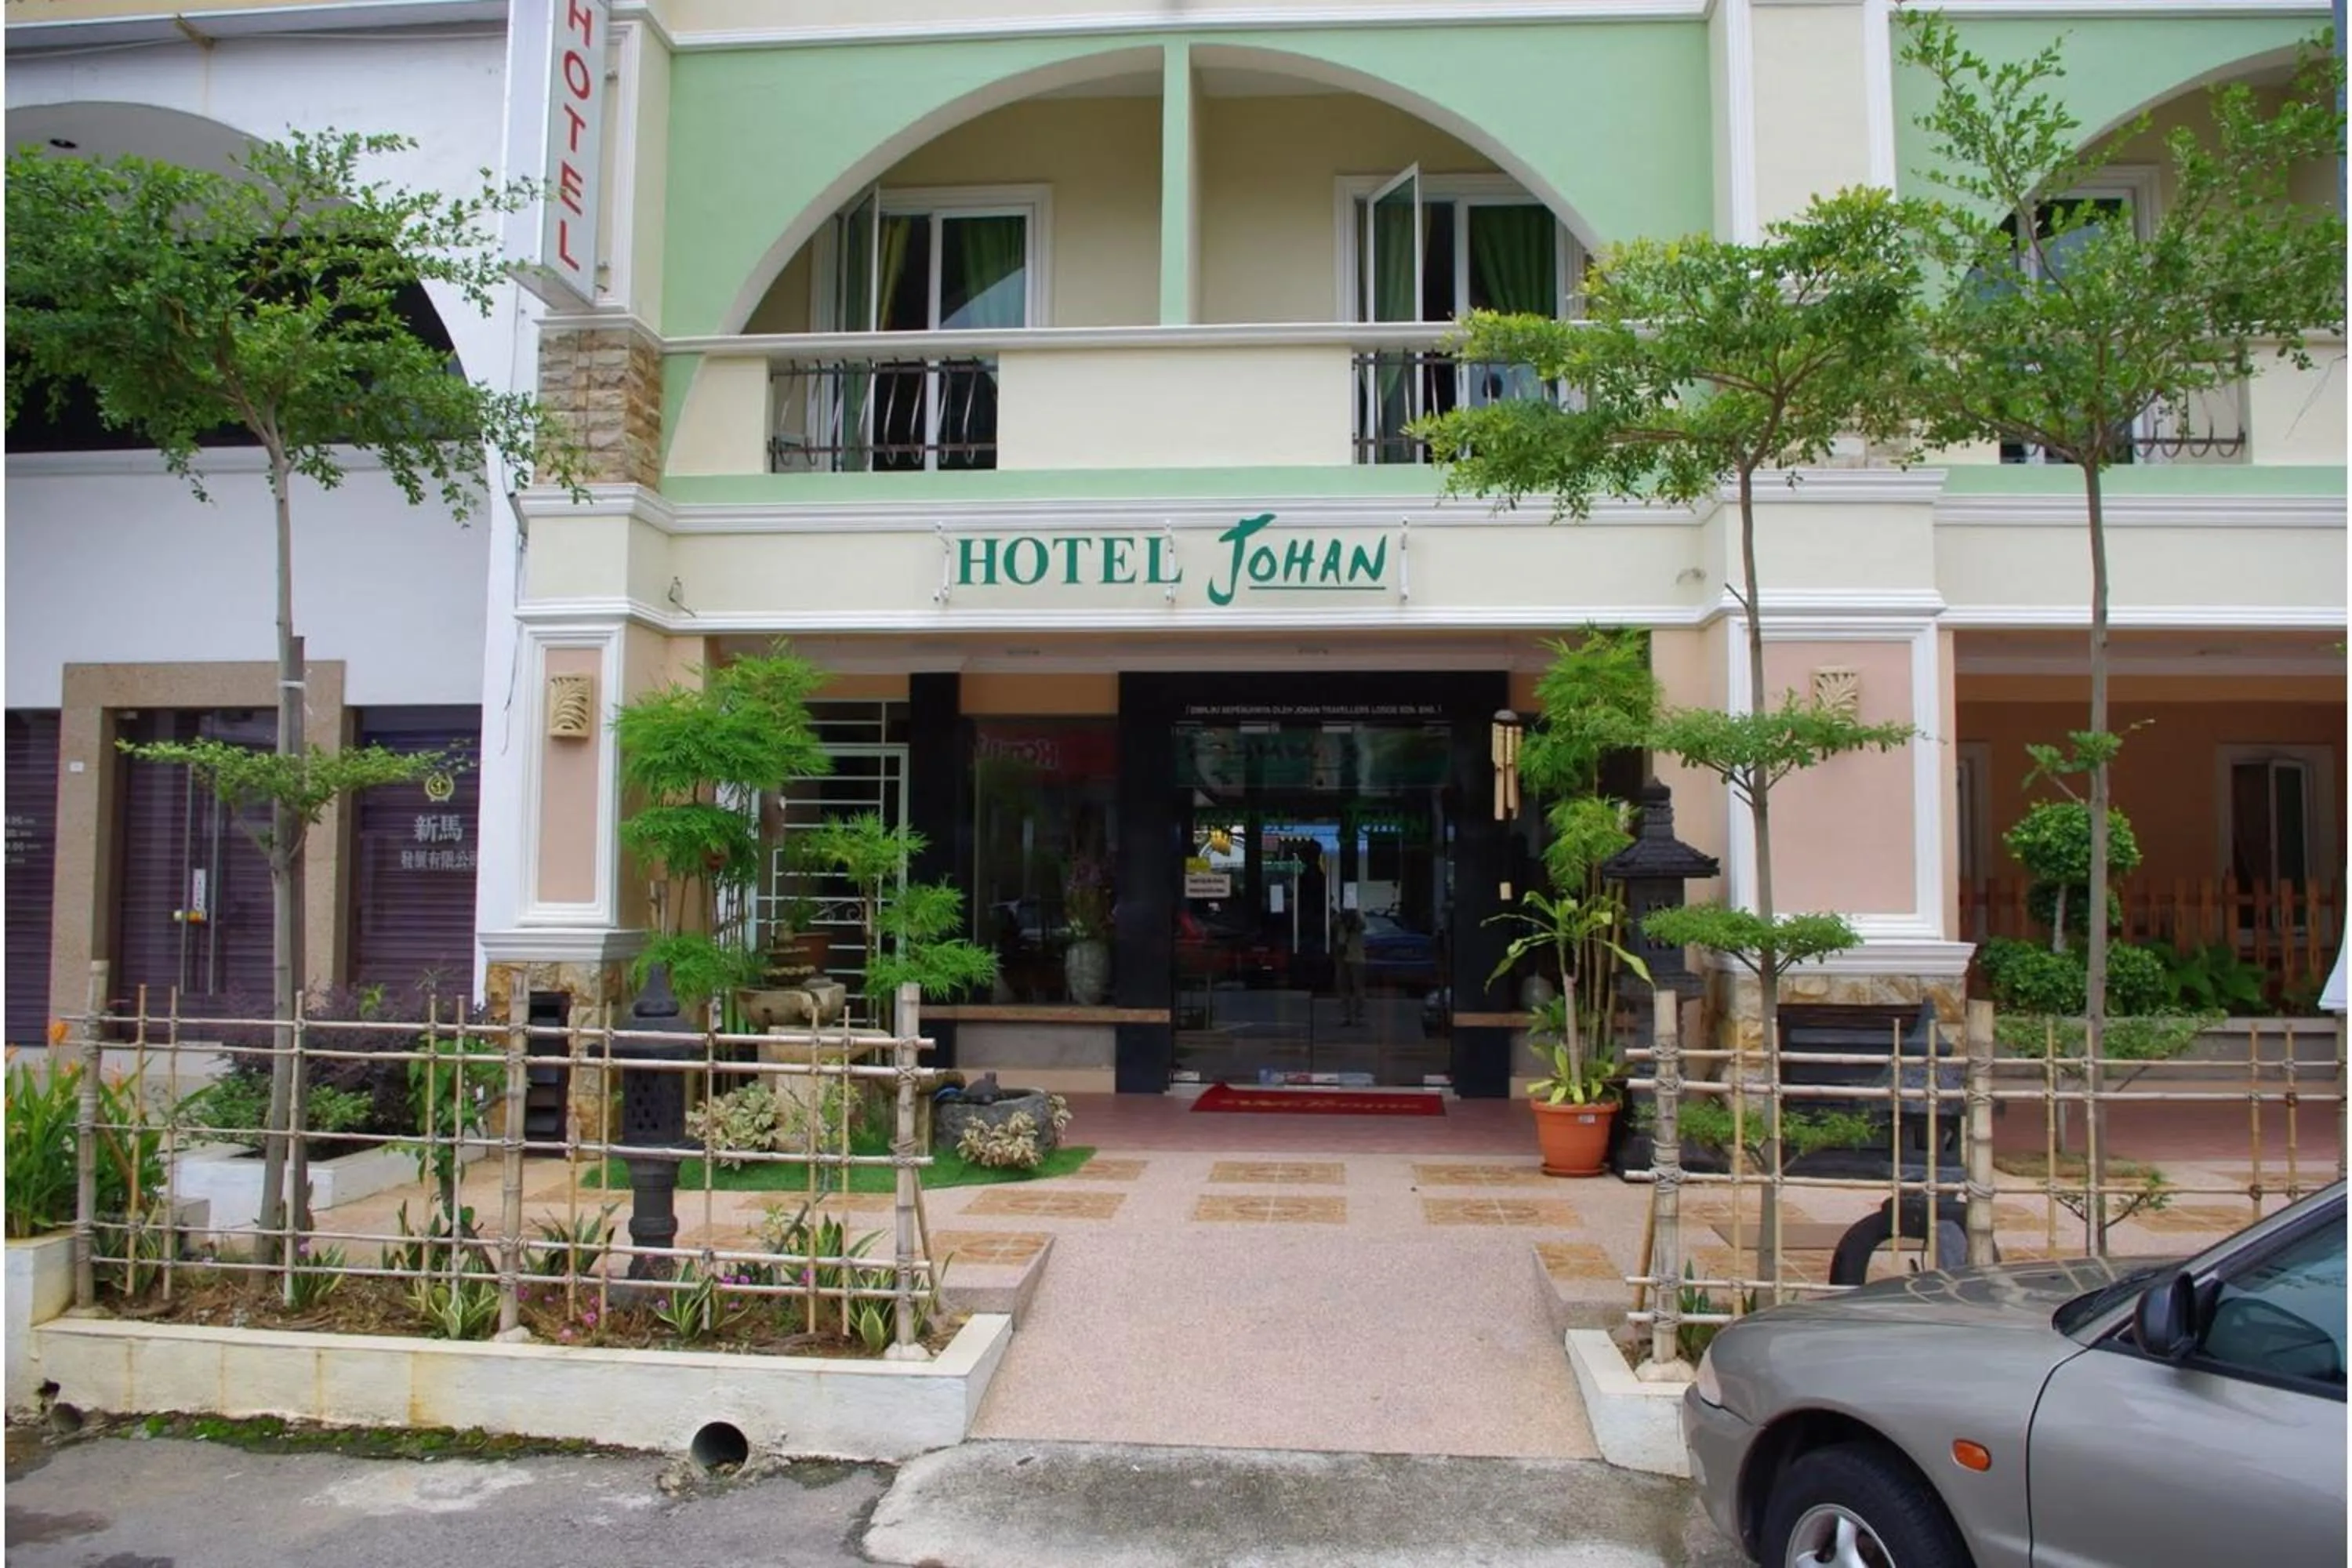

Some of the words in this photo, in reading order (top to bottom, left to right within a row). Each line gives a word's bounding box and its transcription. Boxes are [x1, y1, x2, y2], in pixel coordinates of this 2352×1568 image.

[560, 0, 592, 272] HOTEL
[958, 536, 1182, 586] HOTEL
[1207, 514, 1387, 606] JOHAN
[1294, 706, 1320, 715] JOHAN
[414, 815, 463, 843] 新馬
